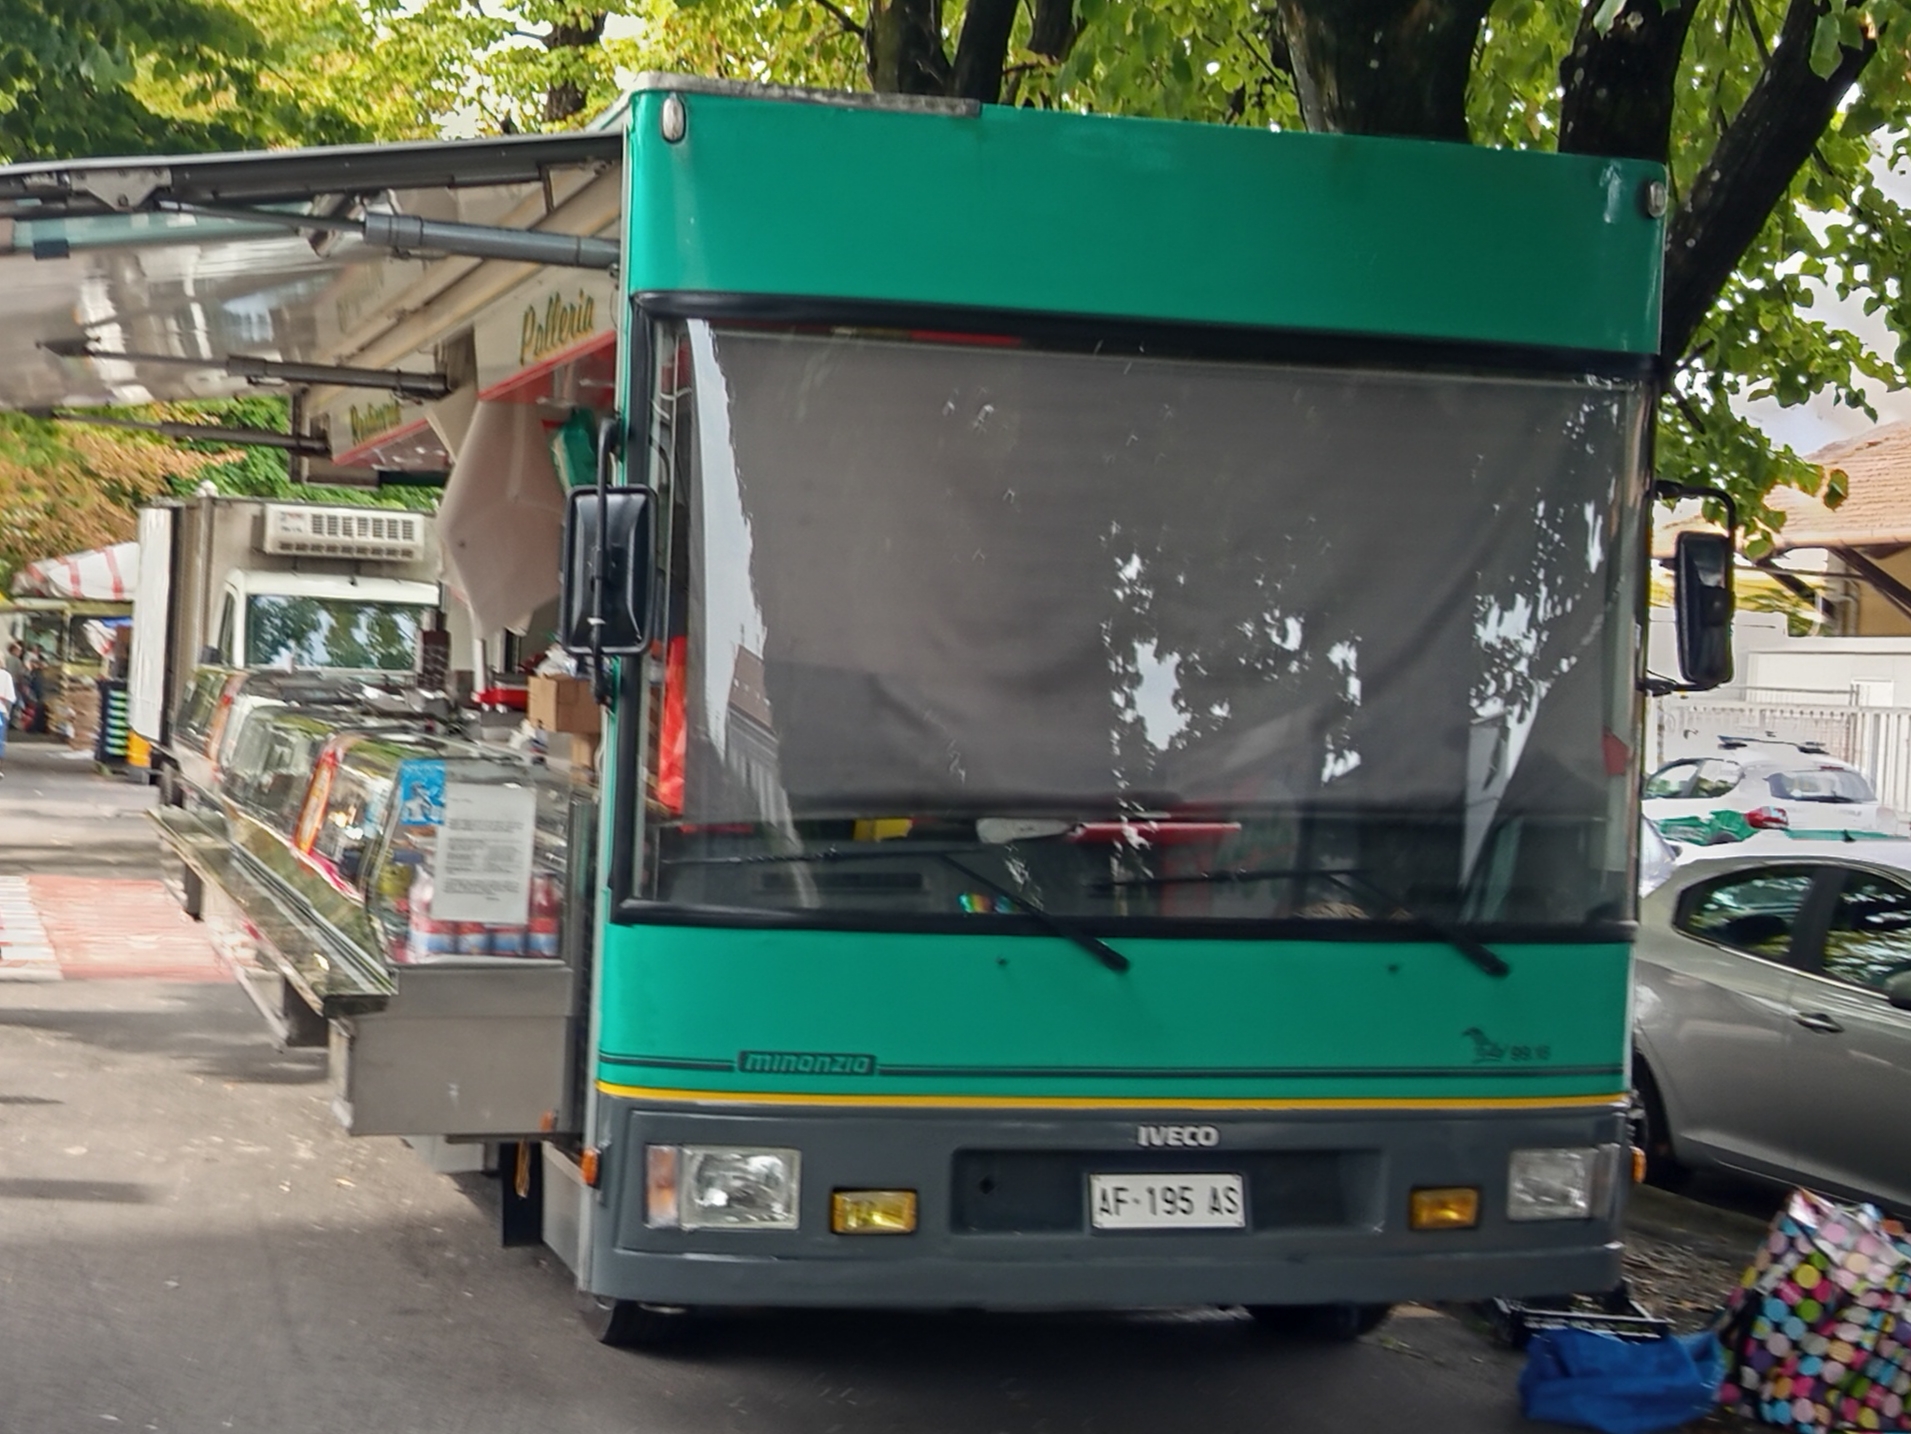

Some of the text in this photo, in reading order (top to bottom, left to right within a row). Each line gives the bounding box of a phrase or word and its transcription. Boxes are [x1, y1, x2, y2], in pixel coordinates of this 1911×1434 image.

[519, 287, 595, 366] Polleria
[1137, 1126, 1219, 1146] IVECO
[1208, 1186, 1240, 1216] AS
